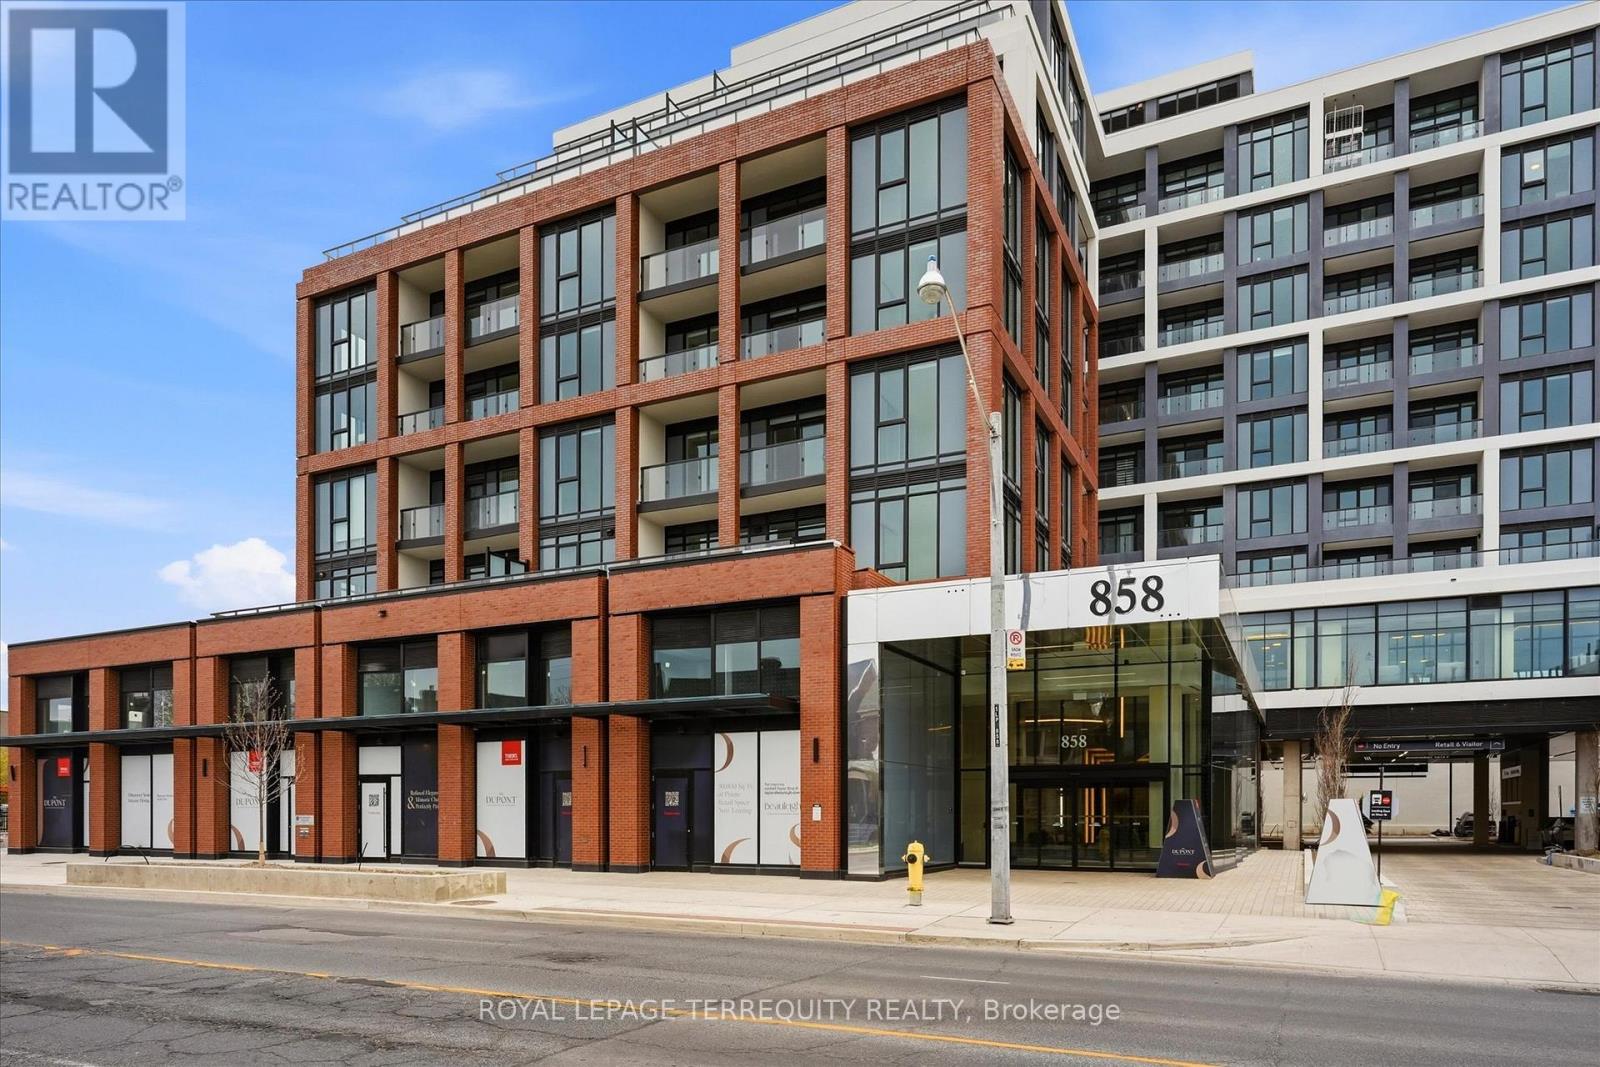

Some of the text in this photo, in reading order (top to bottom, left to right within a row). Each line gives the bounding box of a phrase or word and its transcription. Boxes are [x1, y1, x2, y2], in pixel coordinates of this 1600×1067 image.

[1090, 575, 1165, 616] 858
[1061, 734, 1088, 748] 858
[1383, 742, 1401, 750] Entry
[44, 799, 67, 807] DUPONT
[235, 798, 259, 806] DUPON
[407, 796, 416, 810] &
[485, 796, 517, 804] DUPONT
[1171, 848, 1195, 856] DUPONT
